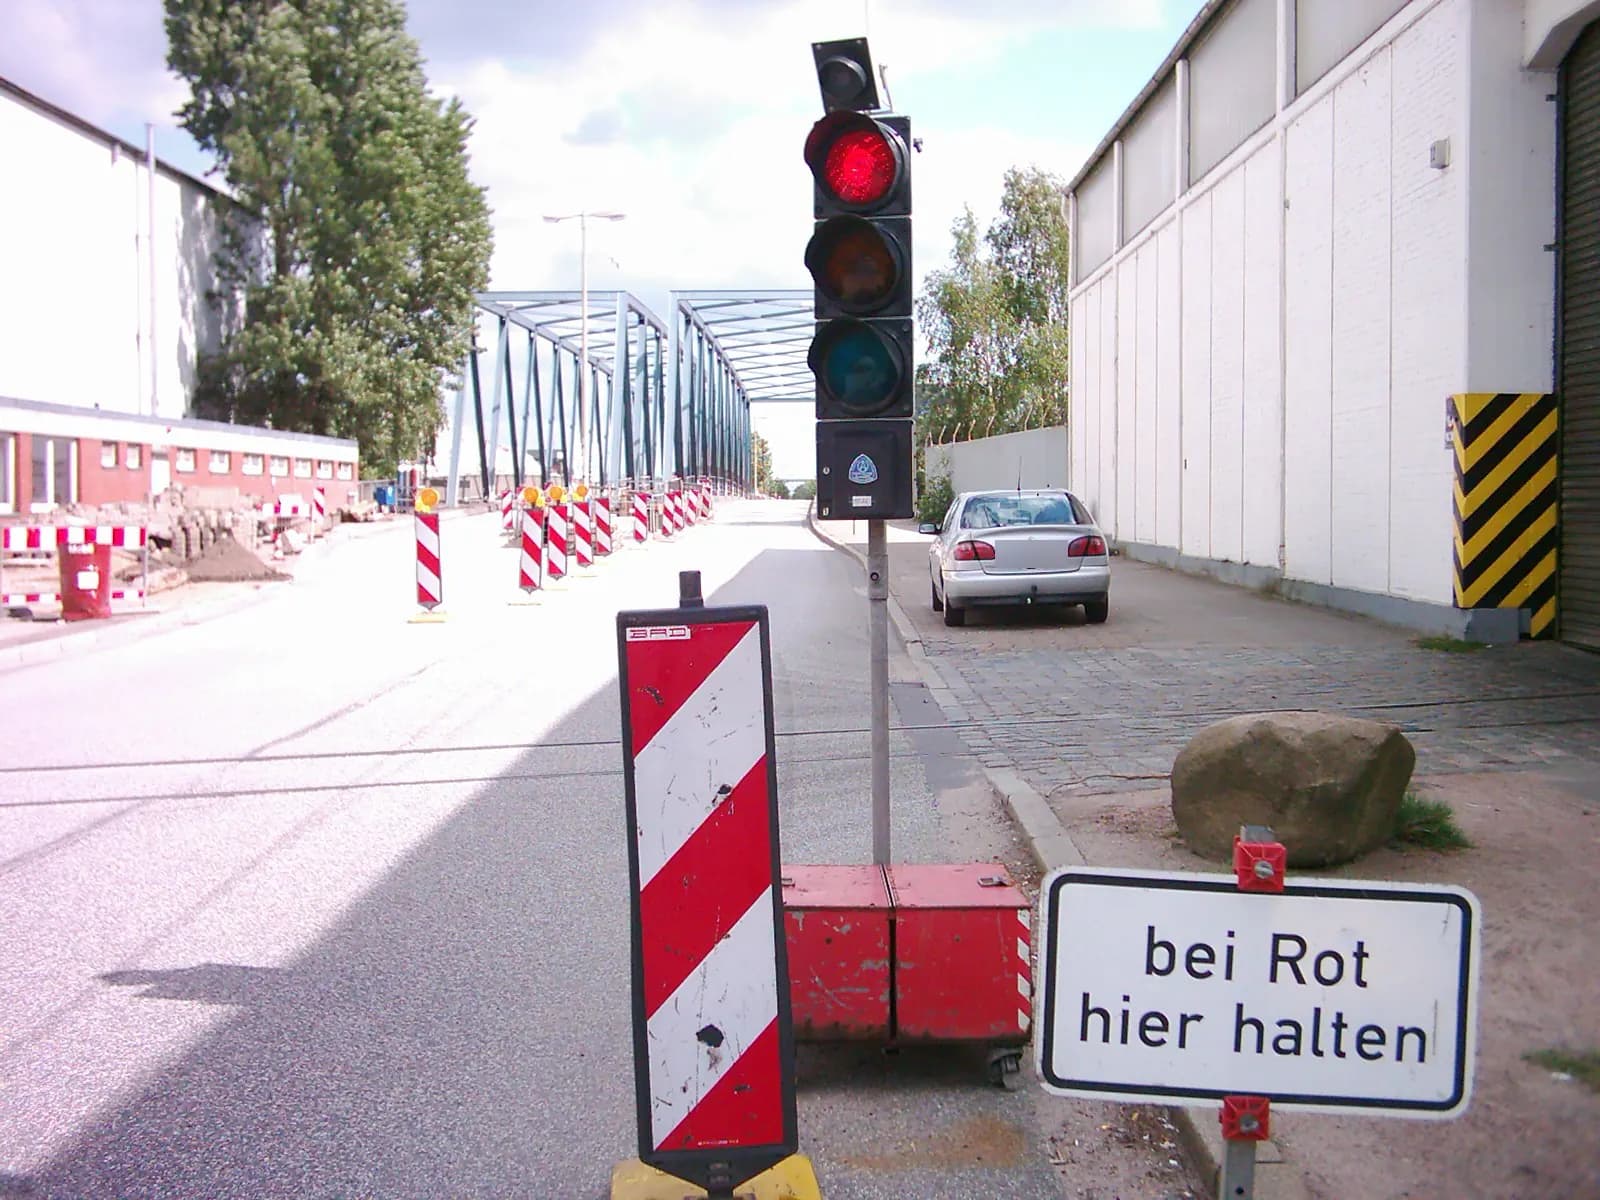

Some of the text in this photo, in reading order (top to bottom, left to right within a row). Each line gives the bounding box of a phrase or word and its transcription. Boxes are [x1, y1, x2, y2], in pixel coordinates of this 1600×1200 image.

[1145, 925, 1370, 989] bei Rot
[1079, 991, 1427, 1064] hier halten
